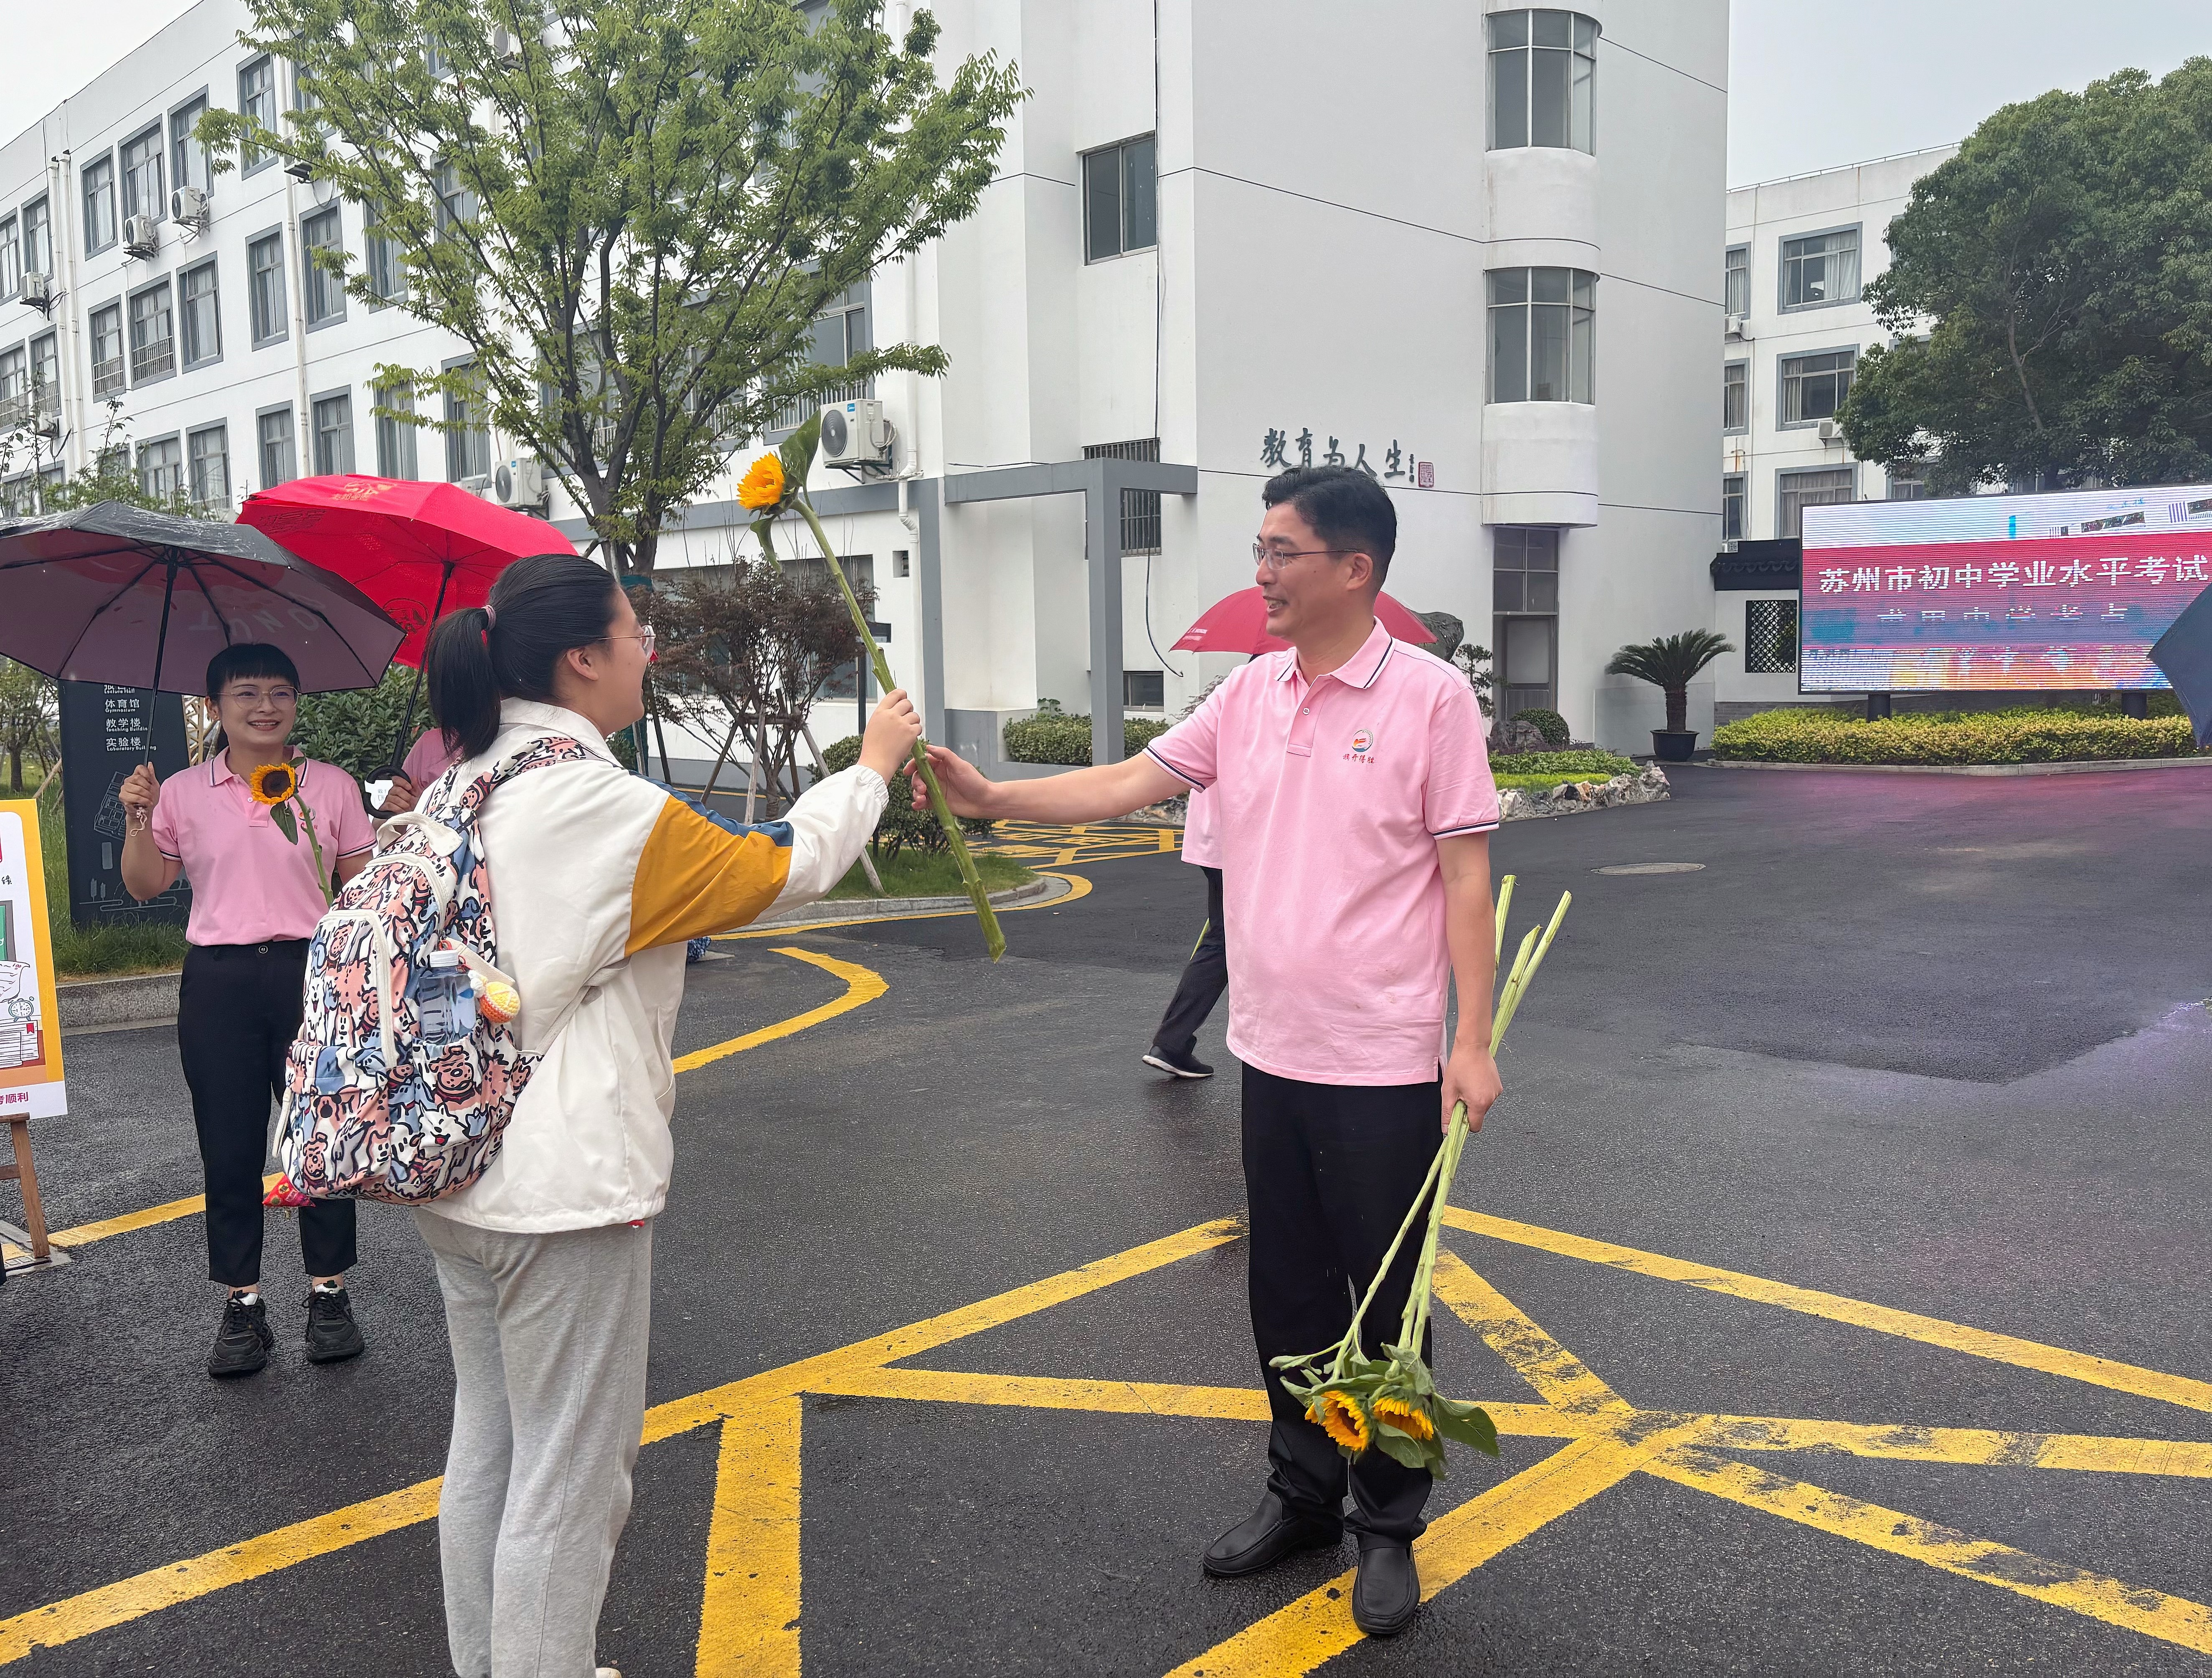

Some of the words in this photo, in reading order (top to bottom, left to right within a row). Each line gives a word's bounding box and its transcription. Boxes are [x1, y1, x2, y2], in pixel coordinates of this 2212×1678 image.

[1819, 554, 2209, 593] 苏州市初中学业水平考试
[105, 699, 140, 709] 体育馆
[106, 717, 141, 728] 教学楼
[106, 737, 141, 747] 实验楼
